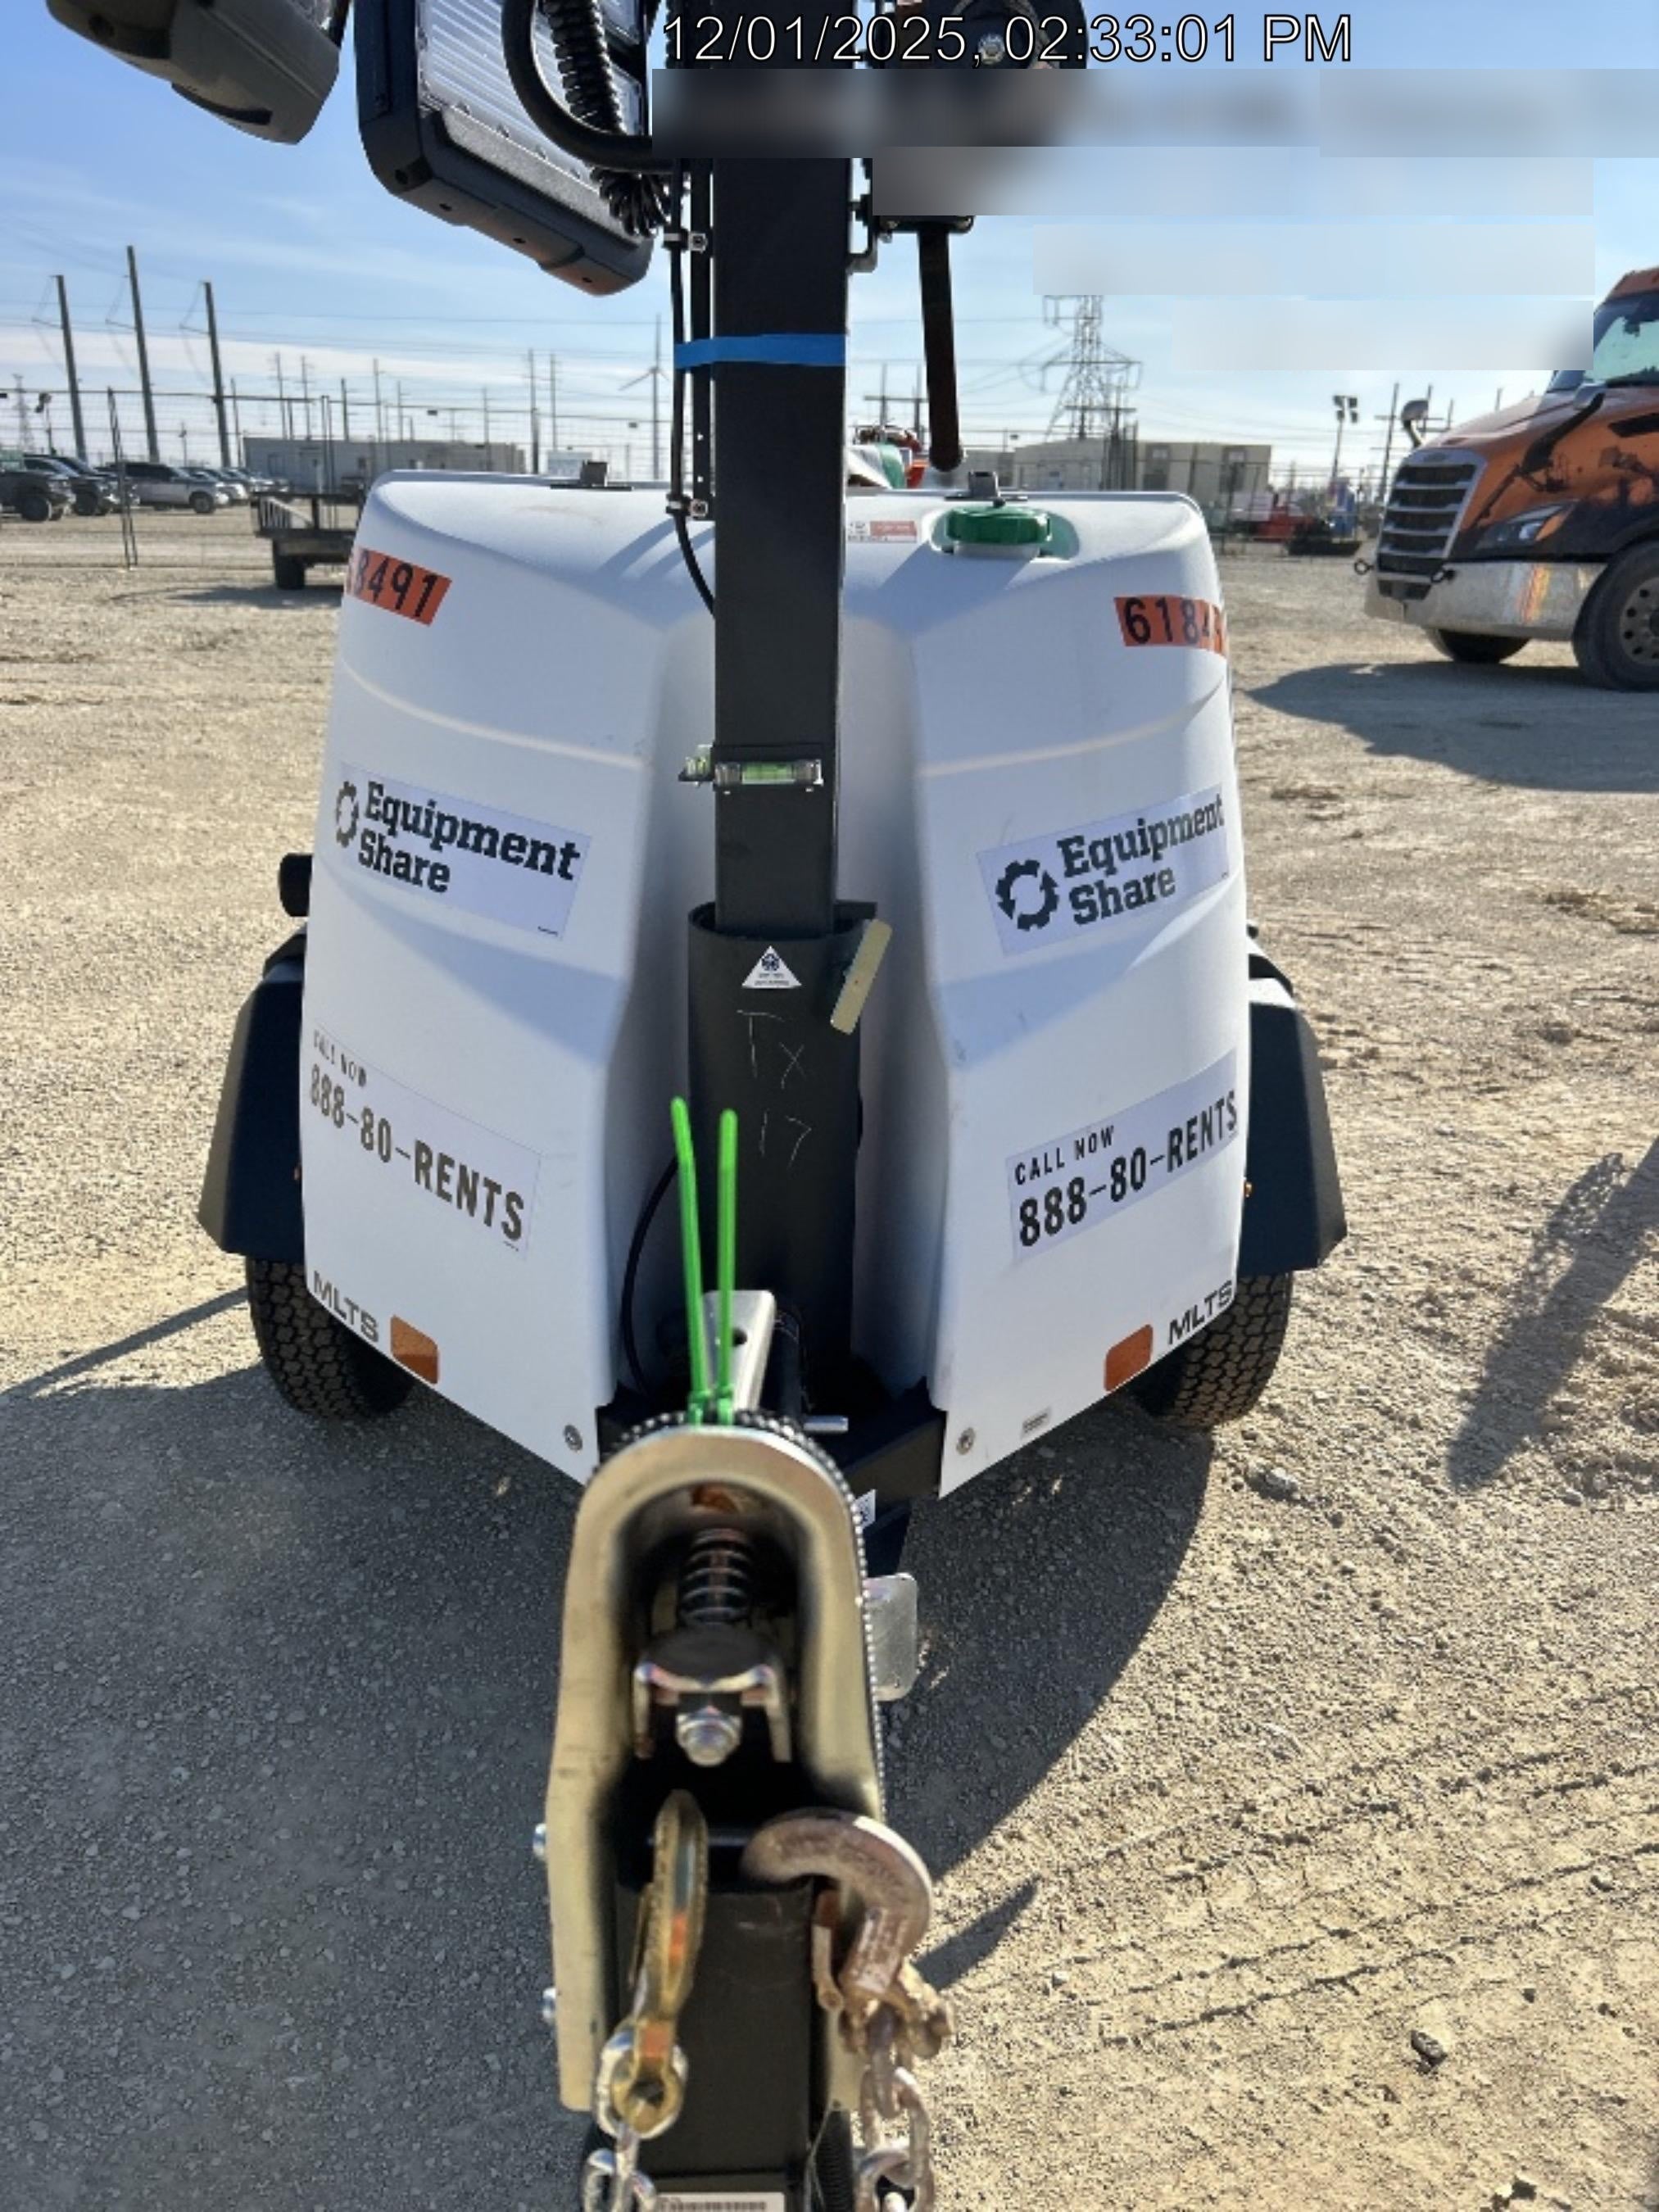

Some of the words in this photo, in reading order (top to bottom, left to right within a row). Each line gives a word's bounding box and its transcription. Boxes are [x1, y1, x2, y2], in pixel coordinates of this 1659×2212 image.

[358, 831, 451, 895] Share
[364, 781, 581, 882] Equipment
[1057, 793, 1225, 877] Equipment
[1069, 865, 1176, 927] Share
[310, 1063, 524, 1241] 888-80-RENTS
[1014, 1147, 1066, 1186] CALL
[1074, 1124, 1115, 1161] NOW
[1018, 1090, 1239, 1248] 888-80-RENTS
[313, 1271, 380, 1344] MLTS
[1167, 1279, 1233, 1346] MLTS
